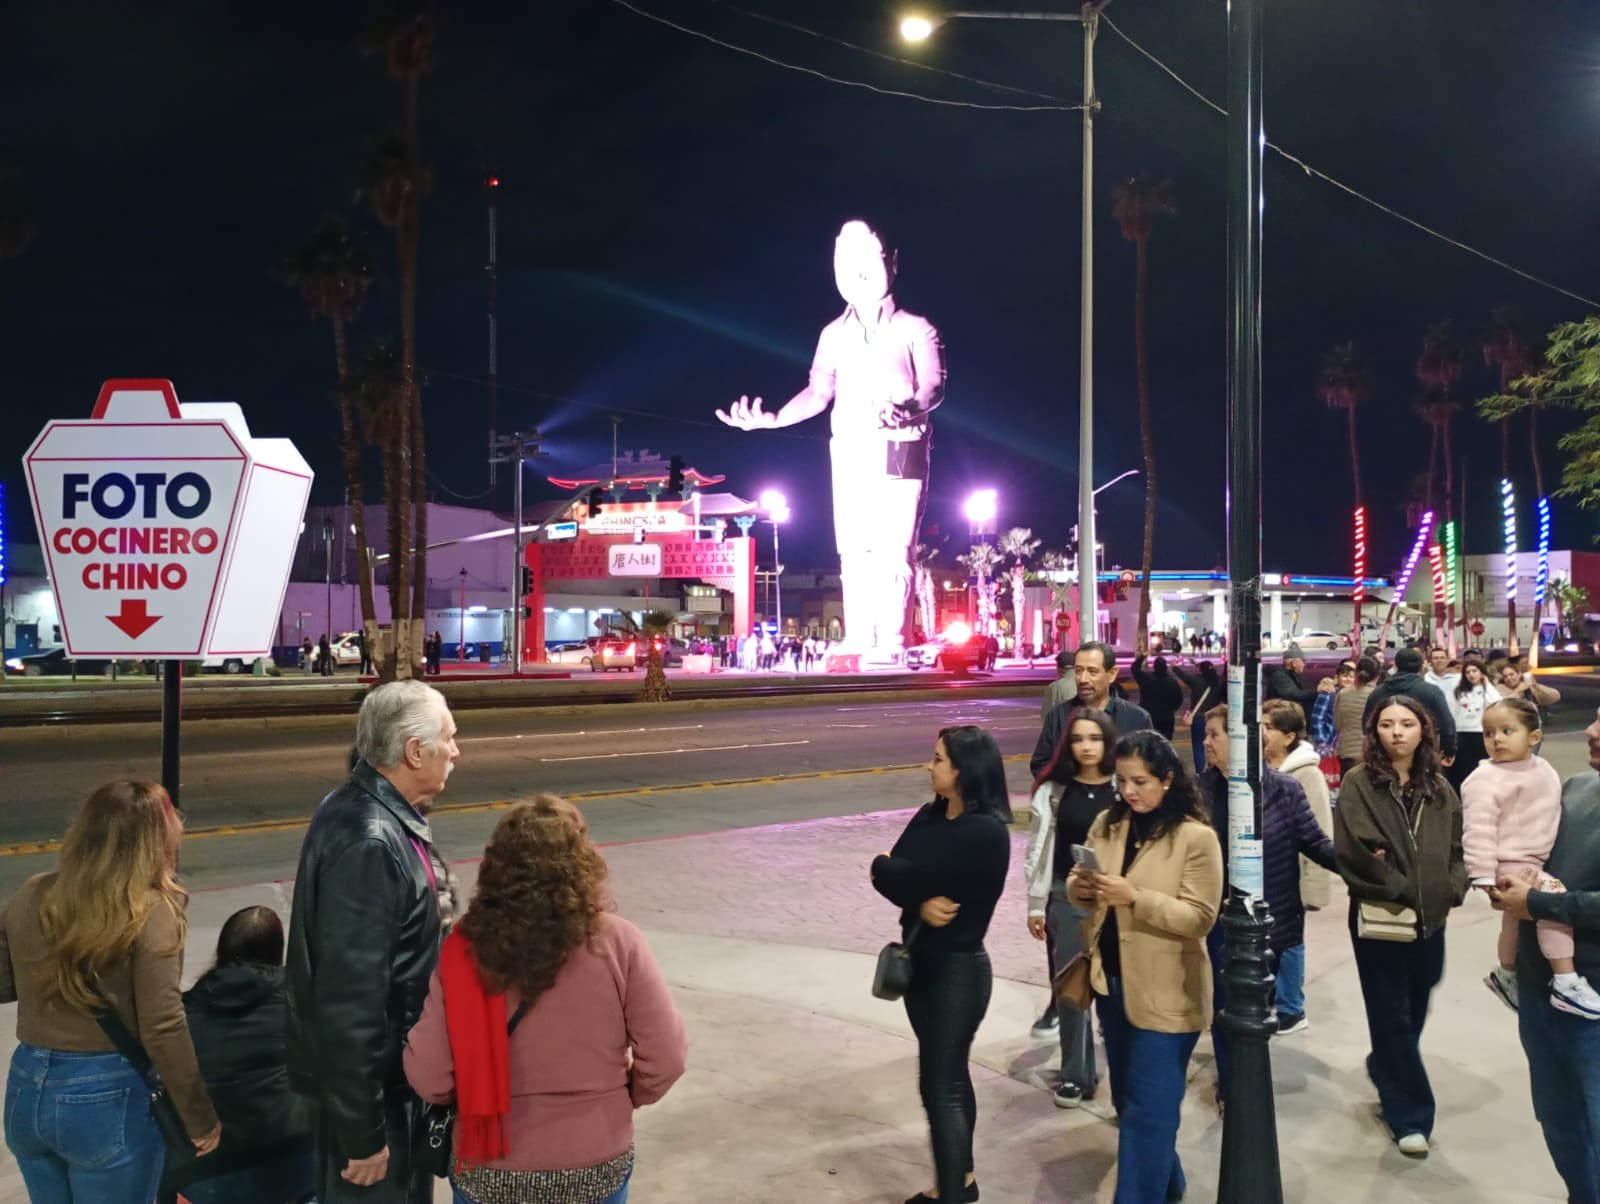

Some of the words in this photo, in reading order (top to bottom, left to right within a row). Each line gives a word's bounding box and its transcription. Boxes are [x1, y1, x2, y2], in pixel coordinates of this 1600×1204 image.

[62, 472, 211, 519] FOTO
[601, 514, 666, 526] CHINSA
[53, 527, 218, 555] COCINERO
[82, 562, 188, 590] CHINO
[1056, 618, 1070, 627] ALTO
